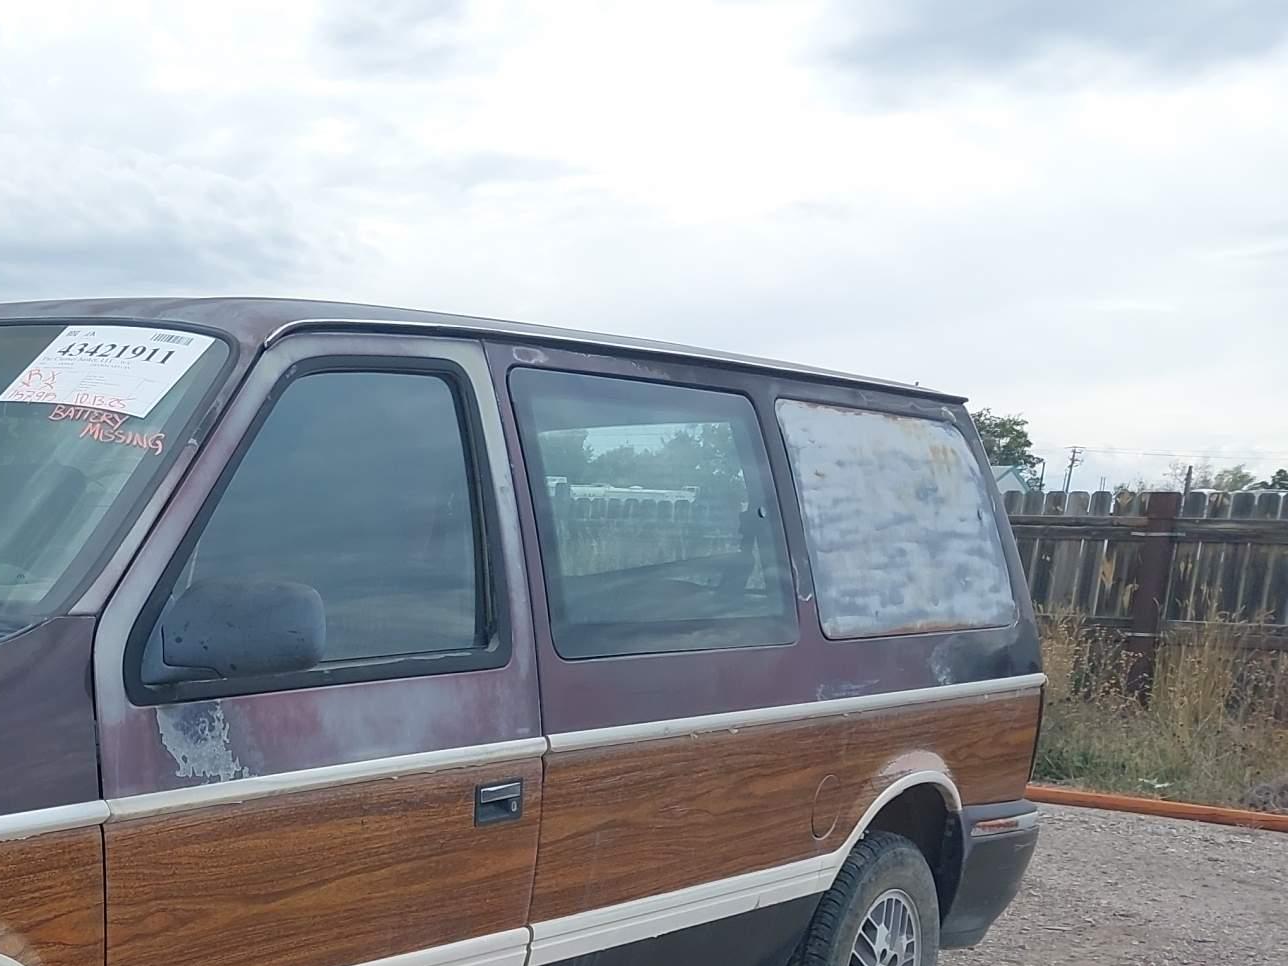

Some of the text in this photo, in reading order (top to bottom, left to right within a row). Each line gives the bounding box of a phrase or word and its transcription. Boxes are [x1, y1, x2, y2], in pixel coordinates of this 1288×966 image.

[57, 342, 176, 365] 43421911
[48, 405, 129, 430] BATTERY
[80, 423, 165, 455] MISSING
